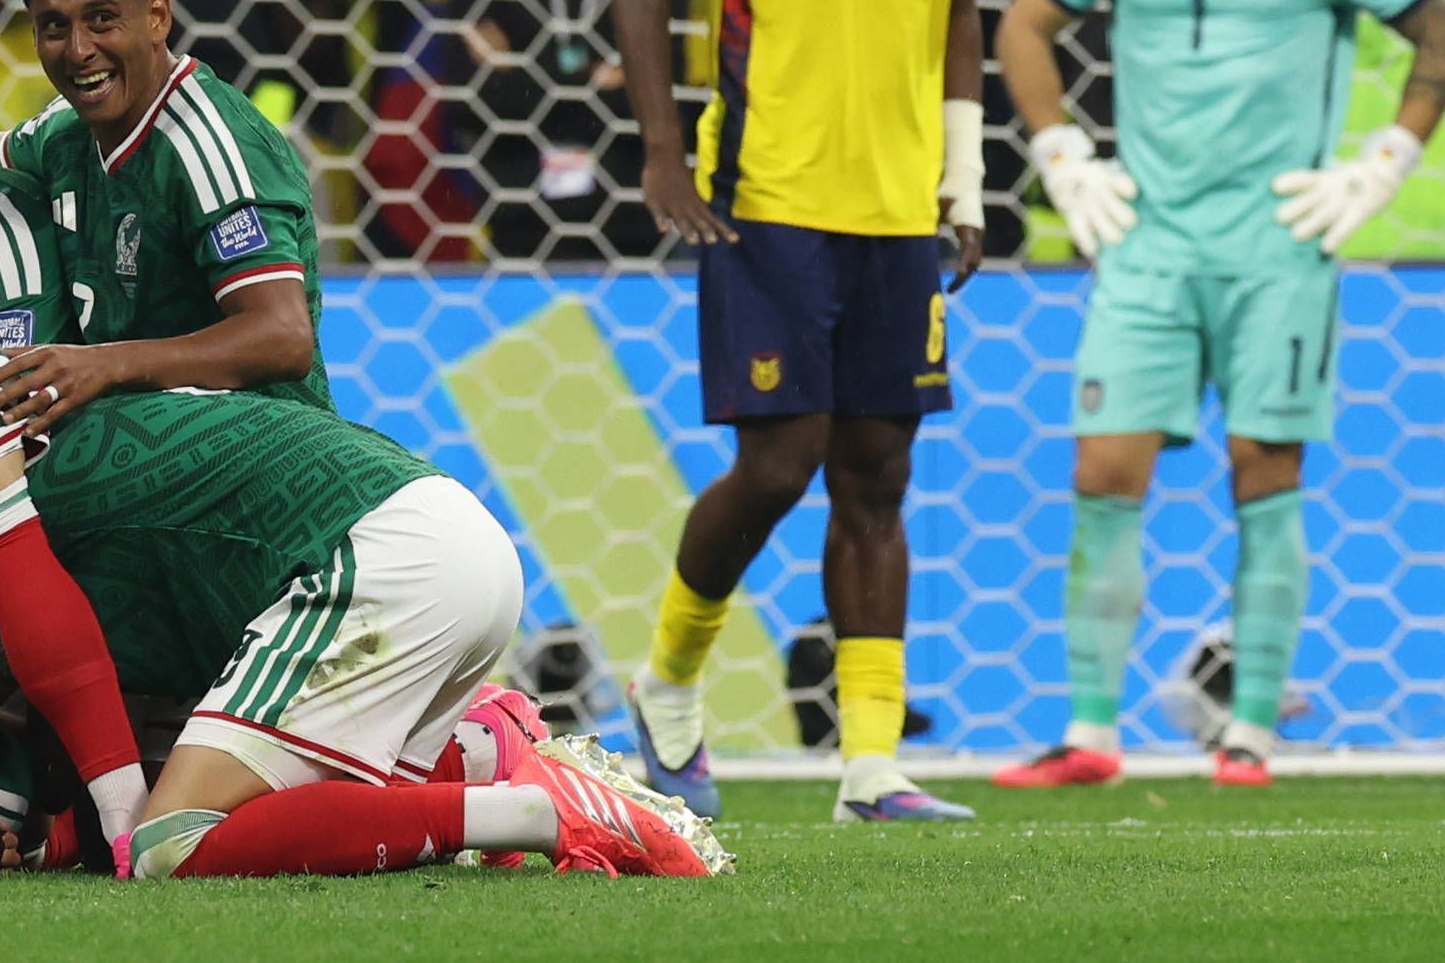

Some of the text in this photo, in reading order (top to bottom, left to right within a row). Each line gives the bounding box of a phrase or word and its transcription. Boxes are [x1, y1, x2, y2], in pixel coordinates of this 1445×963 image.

[216, 215, 252, 238] UNITES
[926, 293, 945, 364] 6
[1289, 335, 1304, 395] 1
